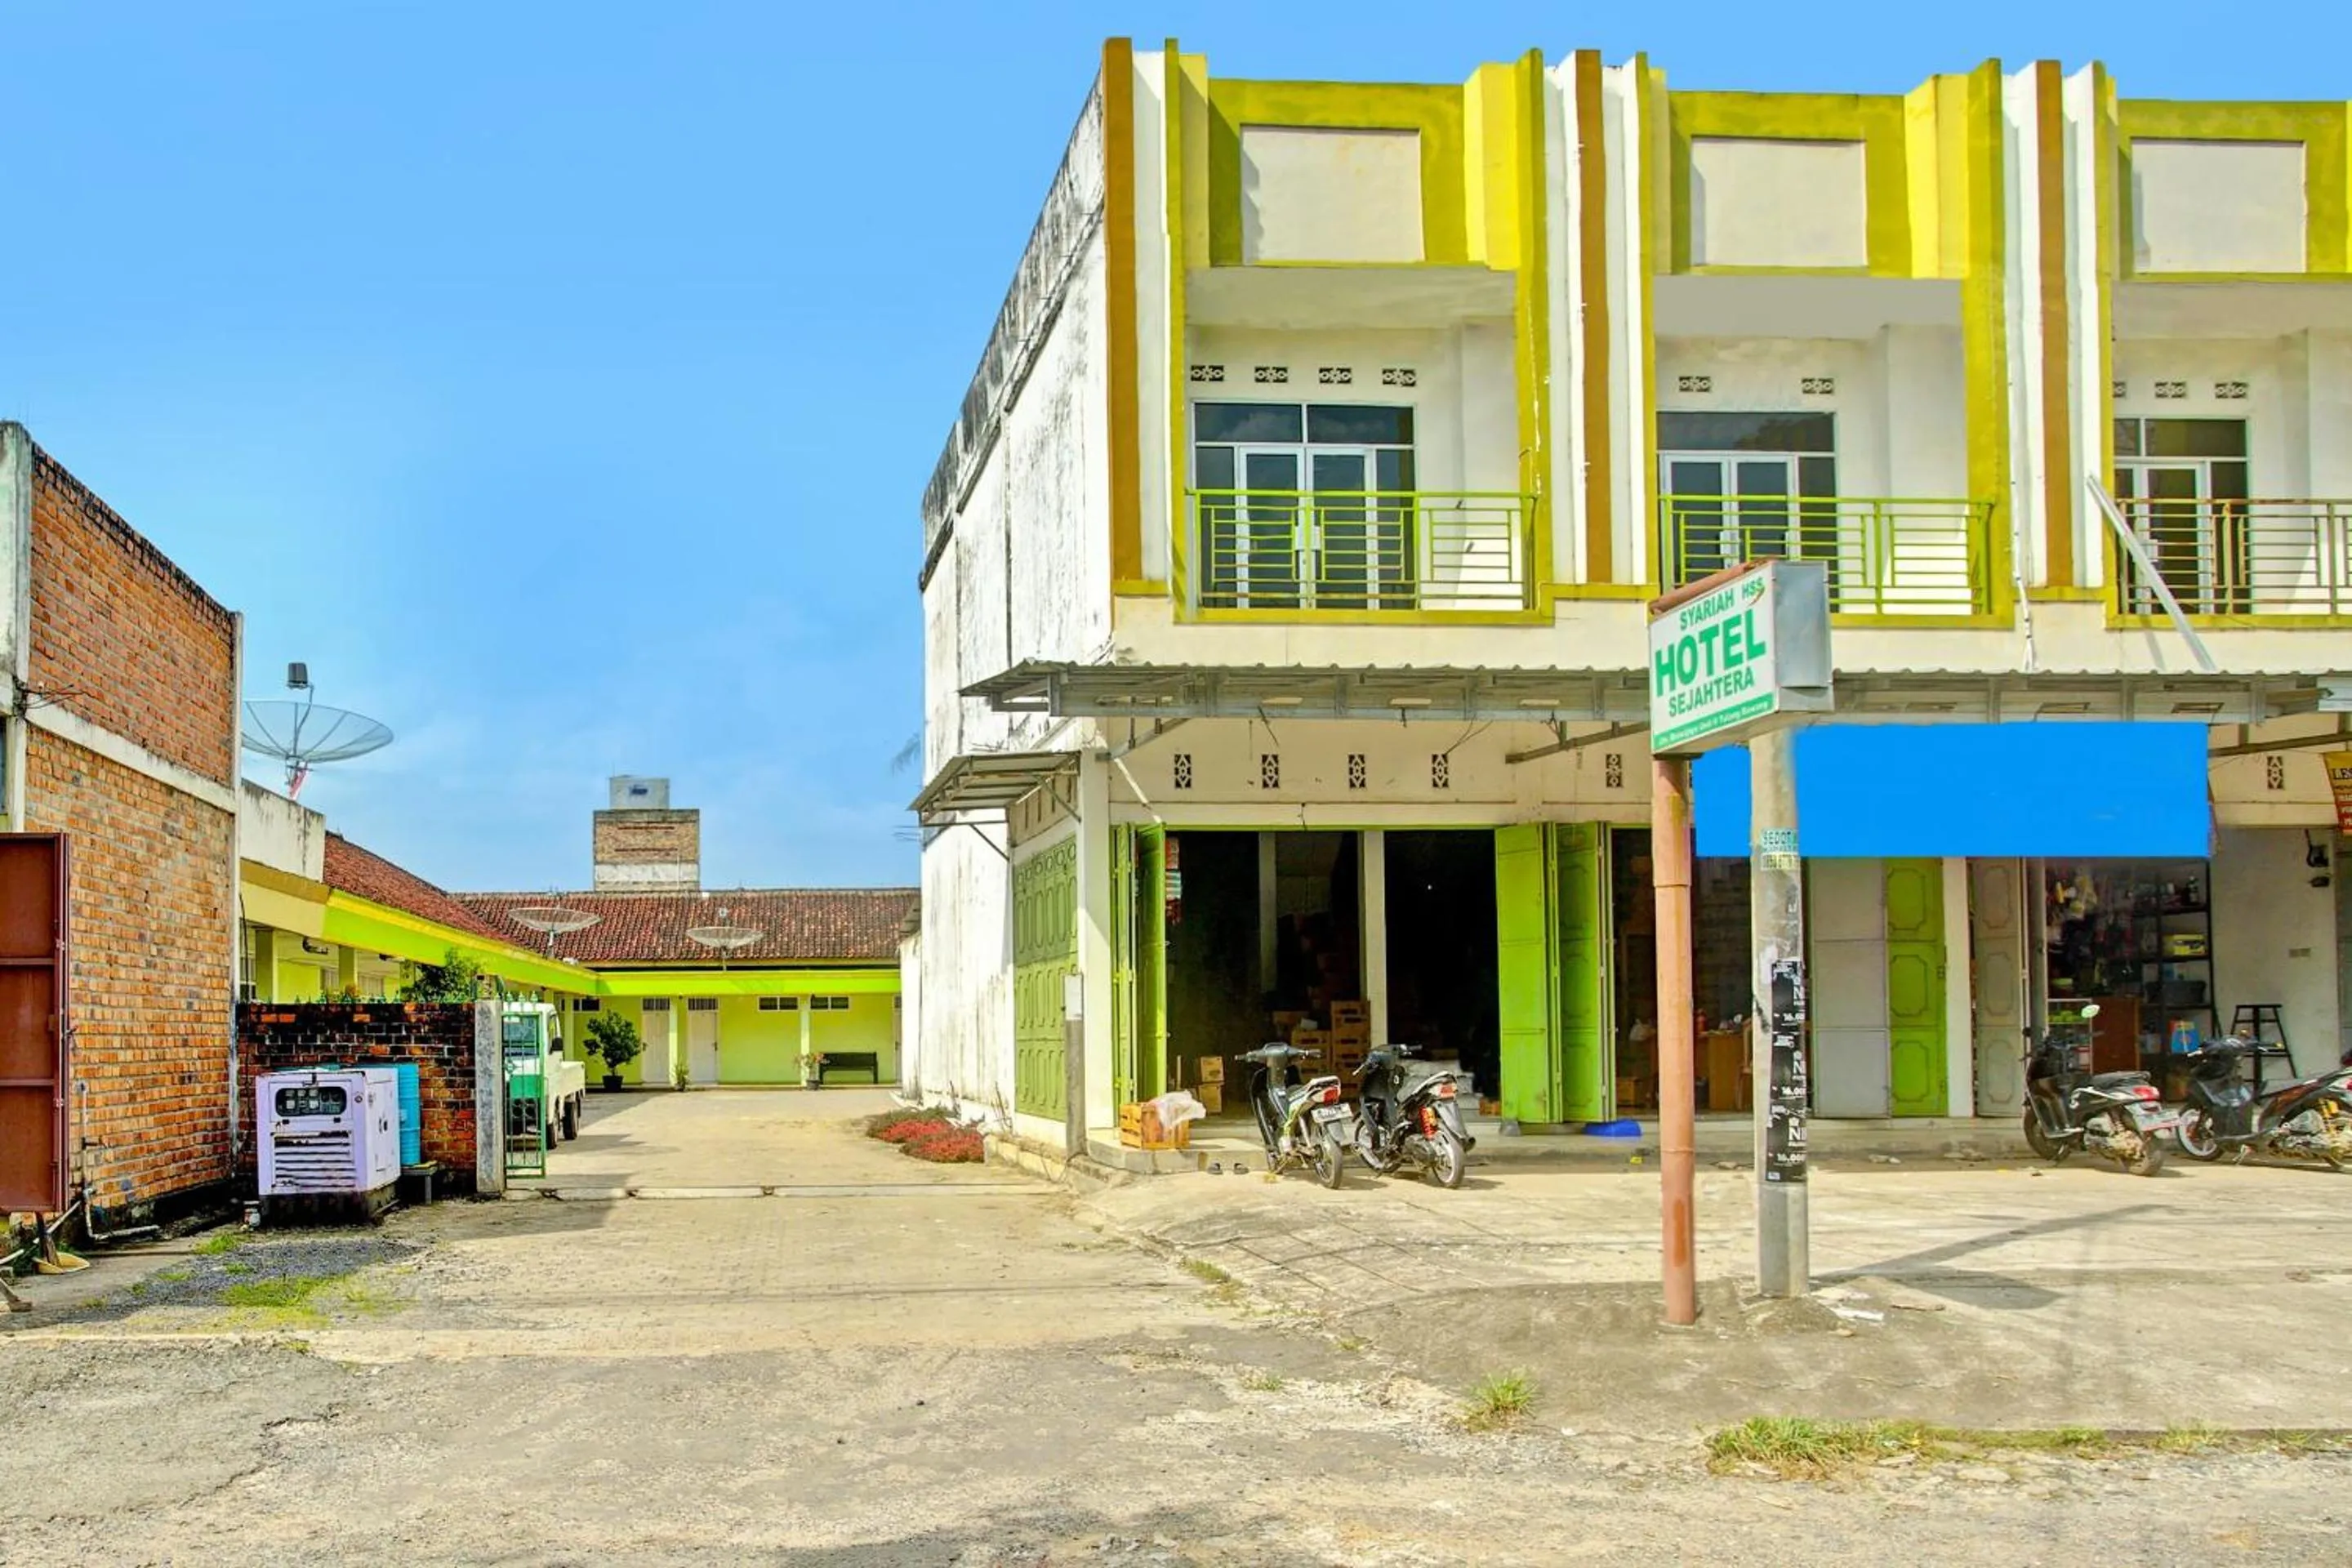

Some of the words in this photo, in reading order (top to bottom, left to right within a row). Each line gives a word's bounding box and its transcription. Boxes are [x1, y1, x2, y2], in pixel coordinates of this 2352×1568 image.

[1680, 588, 1734, 630] SYARIAH
[1655, 609, 1766, 697] HOTEL
[1668, 666, 1754, 717] SEJAHTERA
